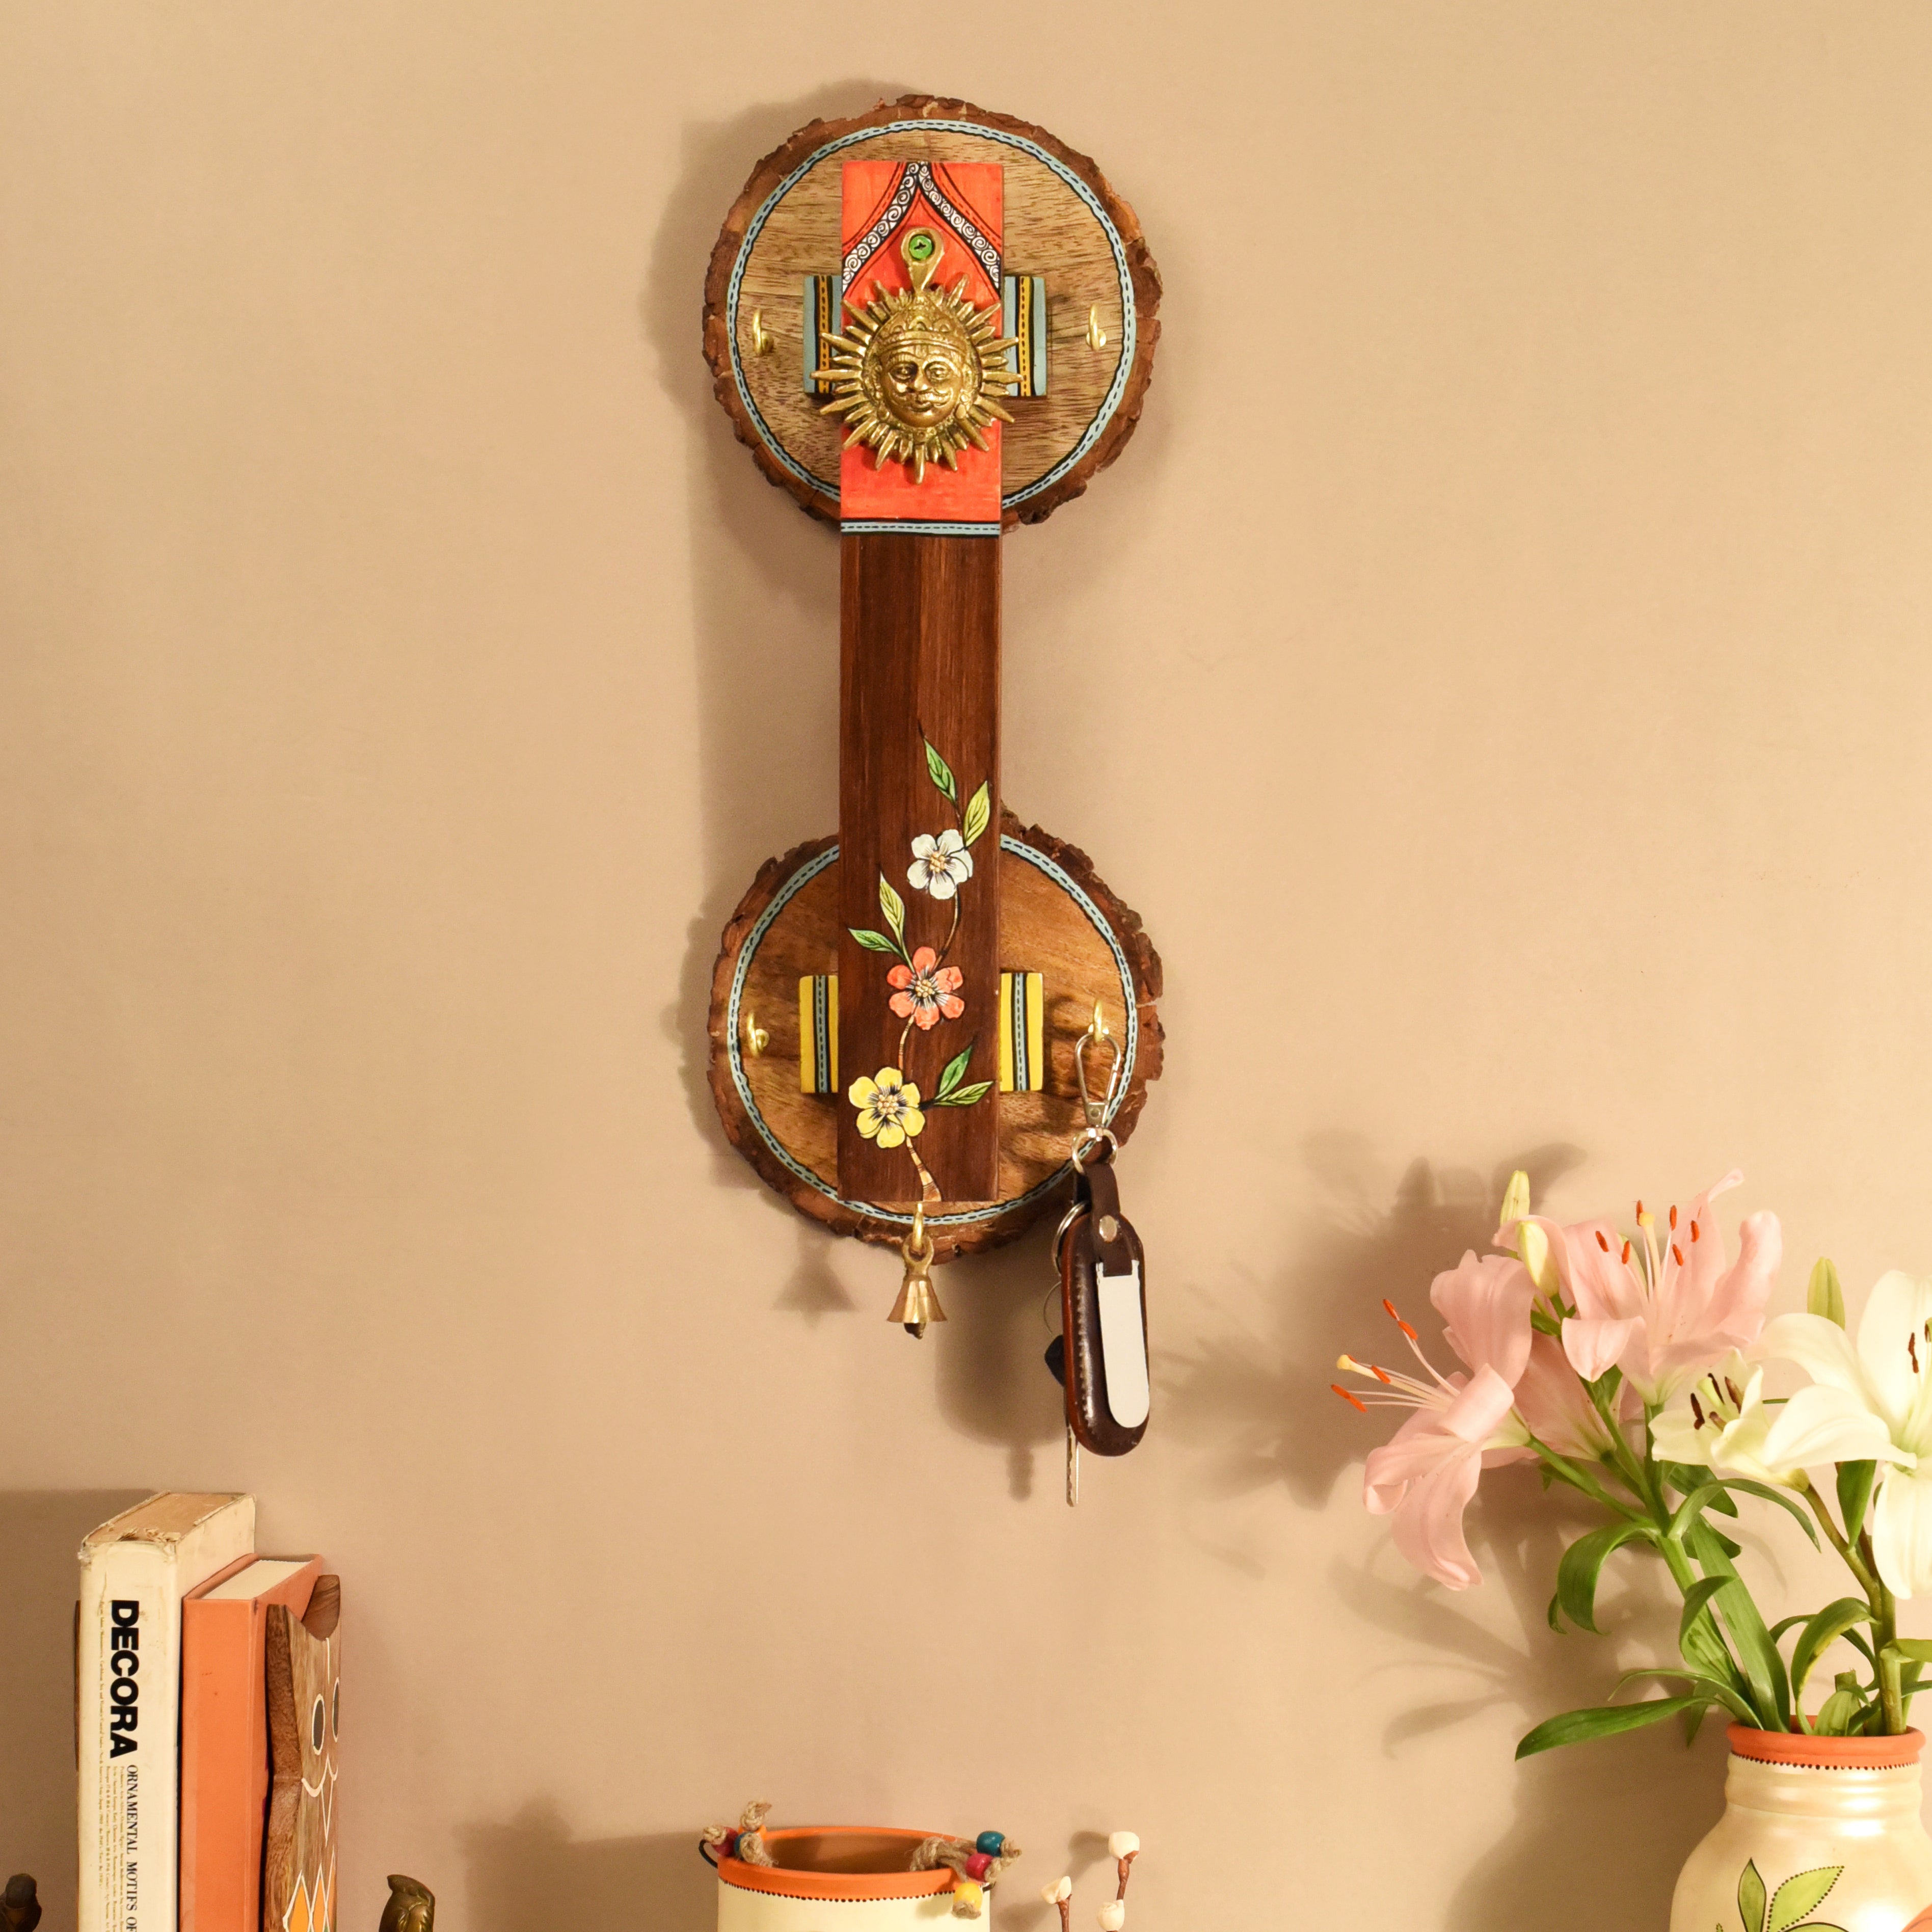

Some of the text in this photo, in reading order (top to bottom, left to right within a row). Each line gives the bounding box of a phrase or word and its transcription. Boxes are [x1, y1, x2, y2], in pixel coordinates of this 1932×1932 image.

[110, 1600, 140, 1758] DECORA
[126, 1764, 139, 1855] ORNAMENTAL
[126, 1862, 138, 1911] MOTIFS
